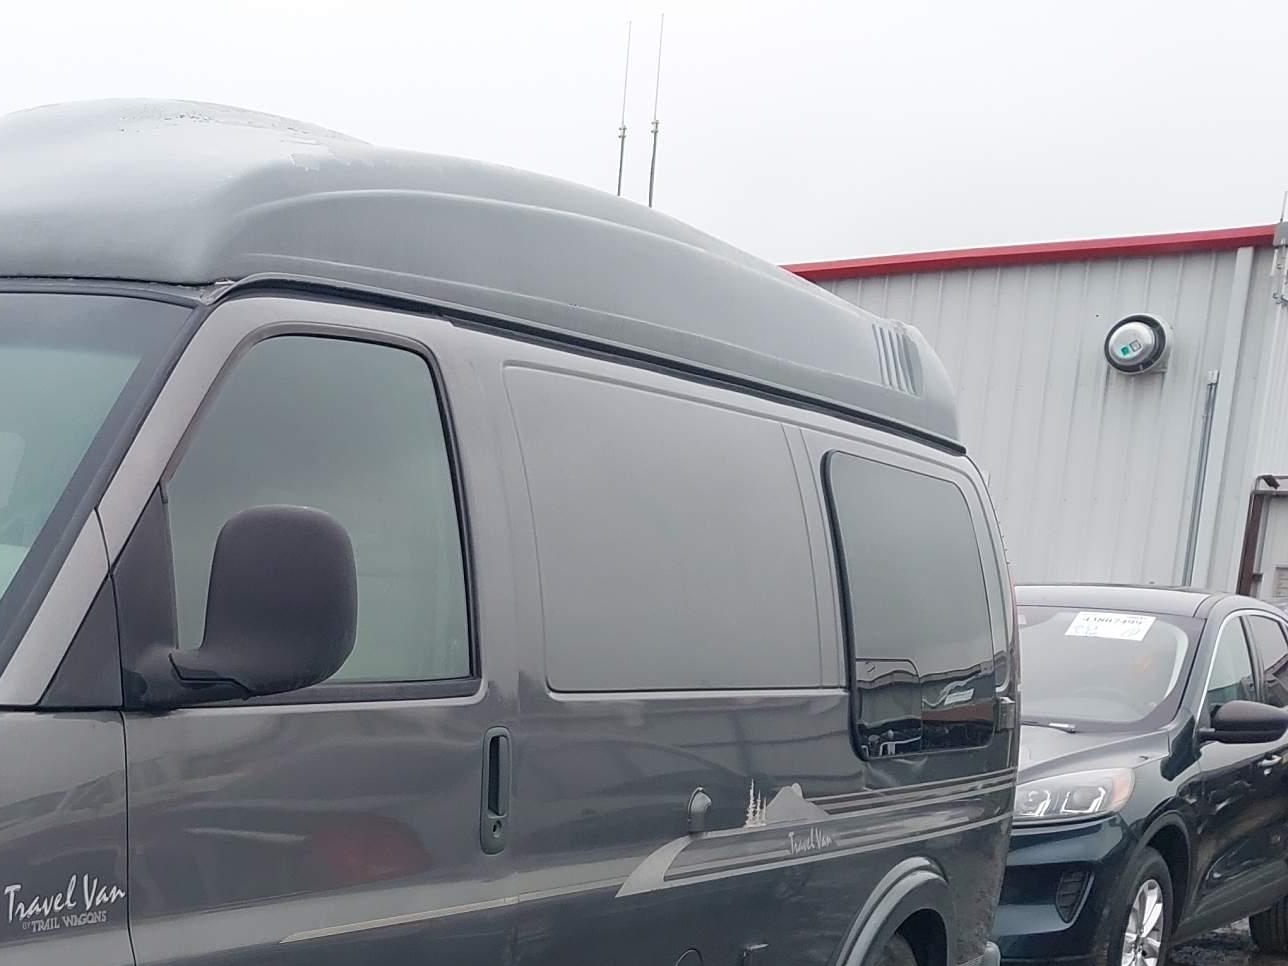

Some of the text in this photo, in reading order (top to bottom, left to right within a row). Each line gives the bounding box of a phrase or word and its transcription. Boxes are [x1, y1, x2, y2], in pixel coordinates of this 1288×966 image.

[788, 827, 832, 855] Travel Van
[4, 873, 126, 923] Travel Van
[31, 917, 60, 933] TRAIL
[62, 910, 108, 928] WAGONS
